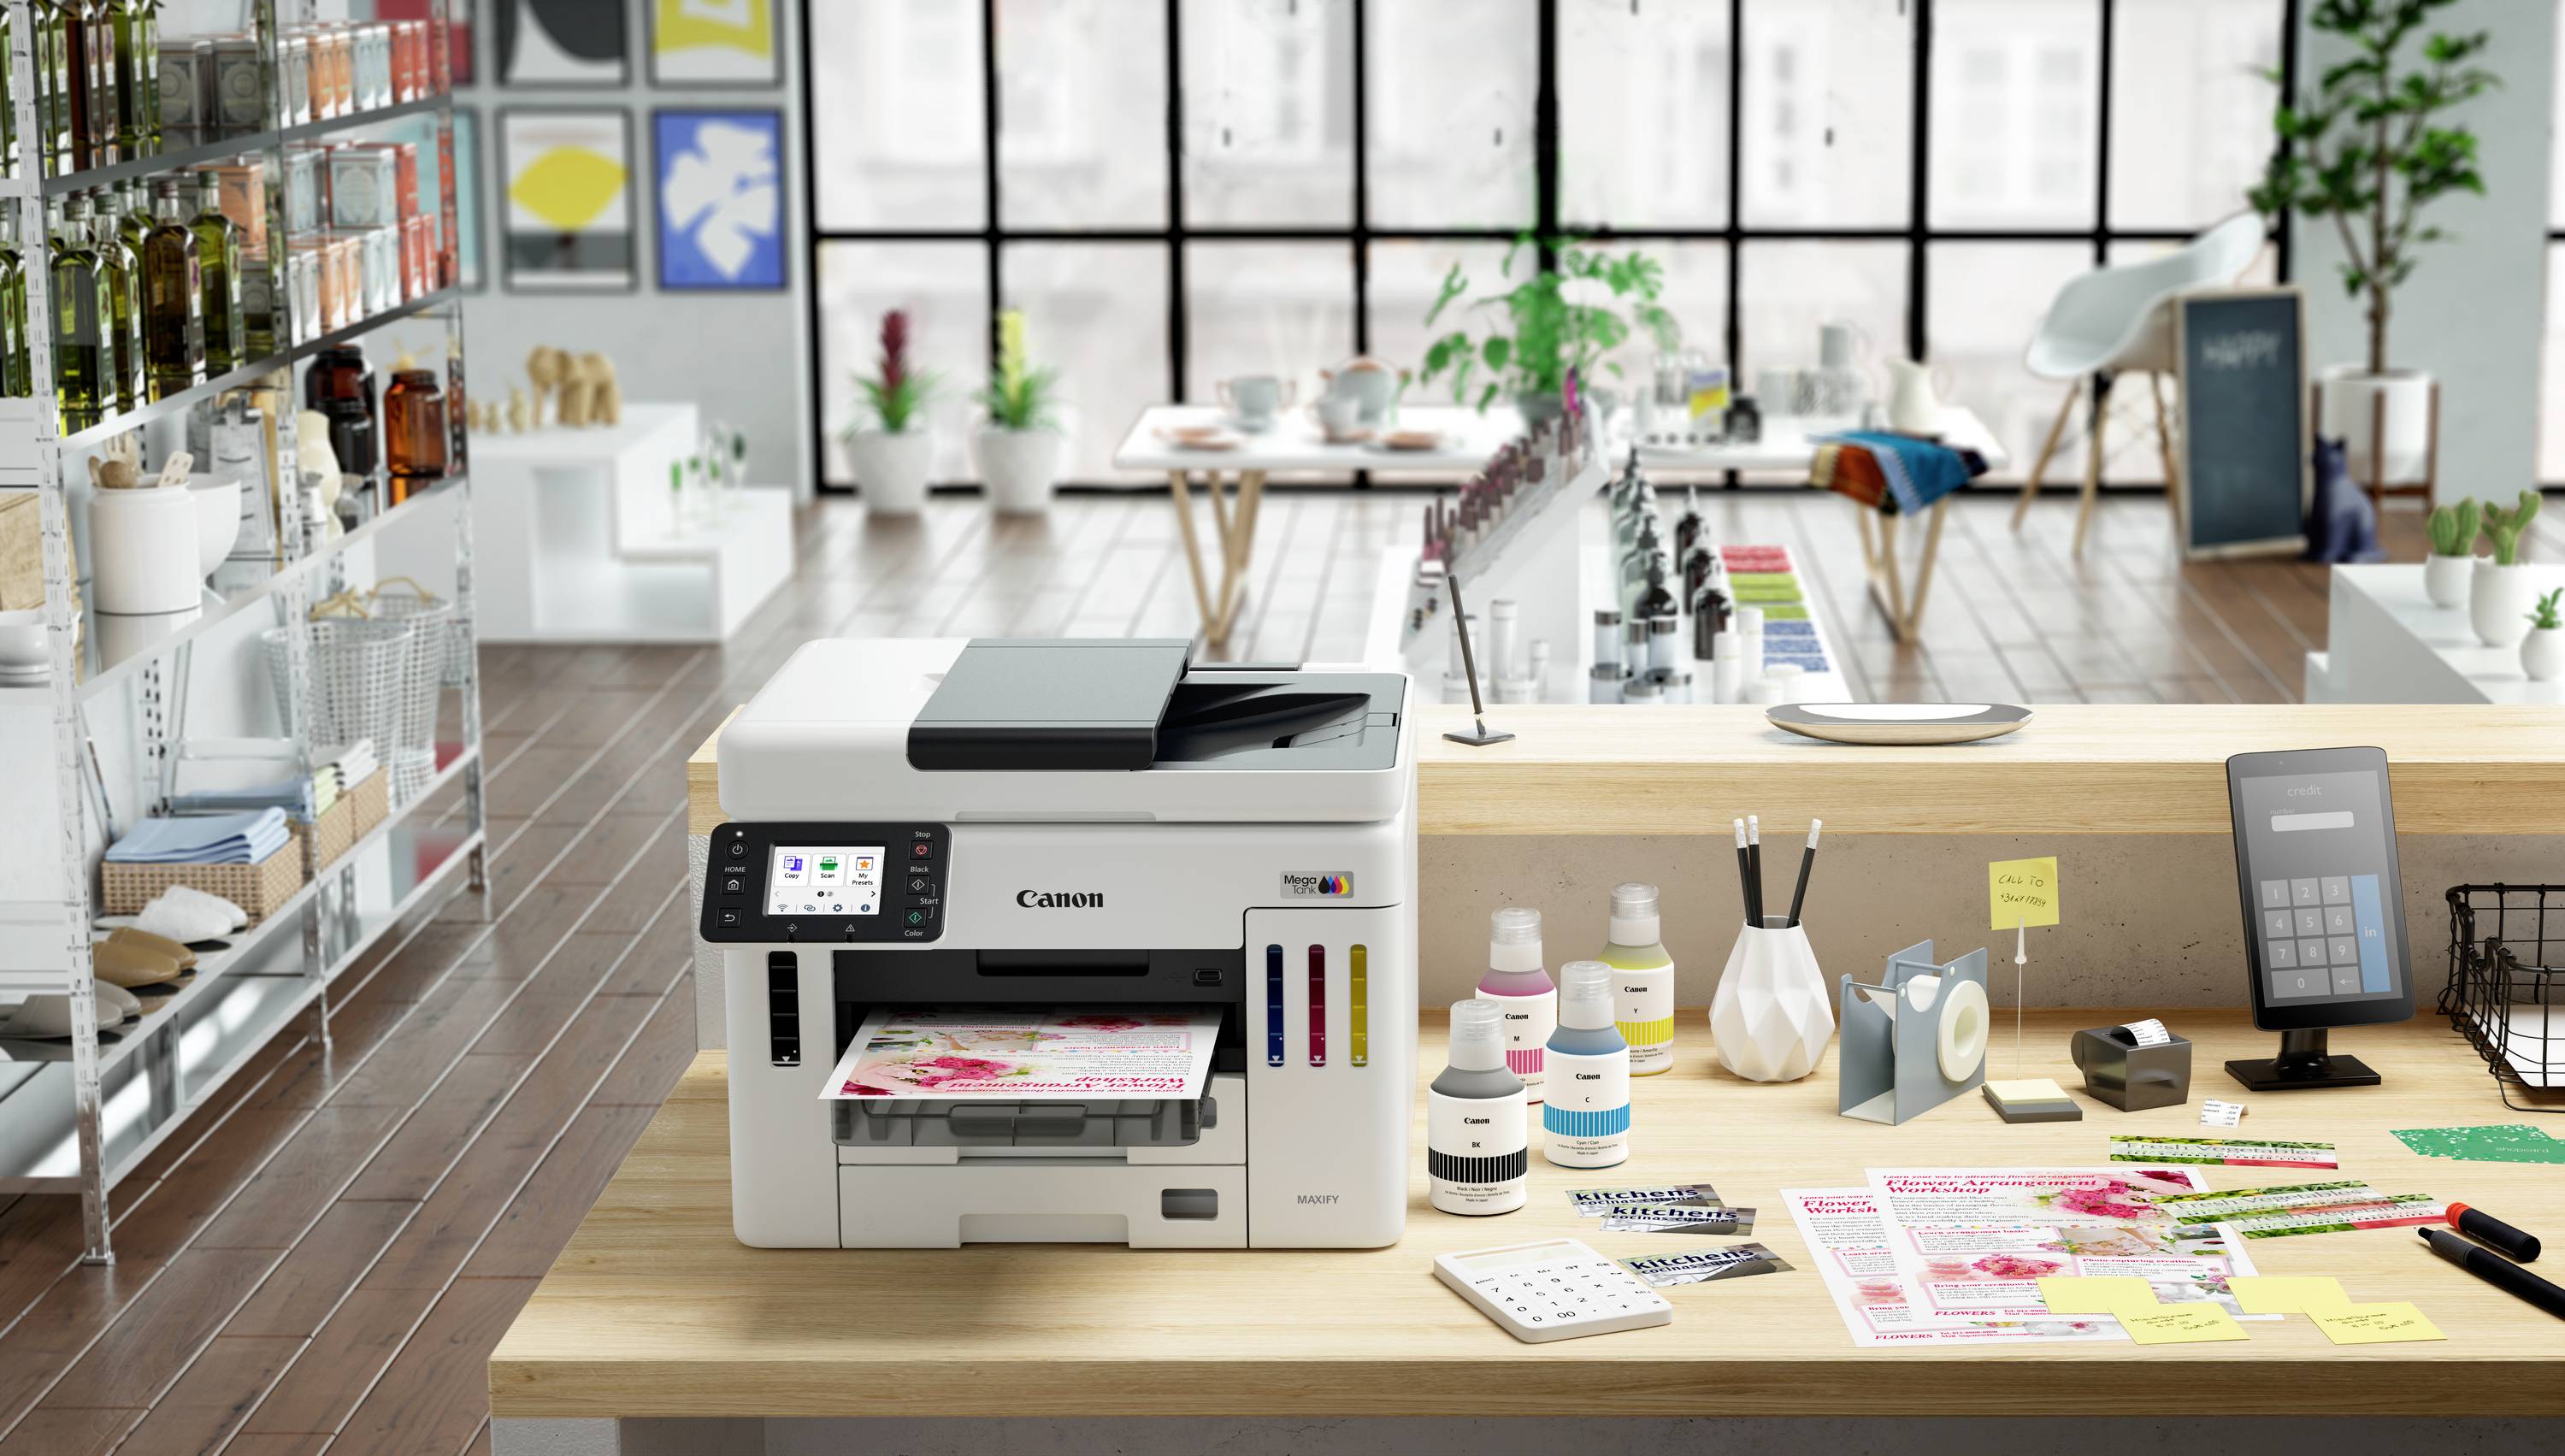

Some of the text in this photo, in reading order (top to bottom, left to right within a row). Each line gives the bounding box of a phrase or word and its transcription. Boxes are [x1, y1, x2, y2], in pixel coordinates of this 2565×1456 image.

[2287, 784, 2322, 797] credit
[1283, 875, 1317, 887] Mega
[1998, 874, 2044, 887] CALL TO
[1292, 884, 1317, 894] Tank
[2302, 887, 2309, 898] 2
[2332, 885, 2338, 896] 3
[1016, 889, 1104, 908] Canon
[2275, 917, 2284, 929] 4
[2306, 917, 2314, 928] 5
[2335, 915, 2343, 926] 6
[2364, 926, 2377, 937] in
[2279, 948, 2286, 959] 7
[2309, 946, 2316, 958] 8
[2338, 945, 2346, 956] 9
[2297, 977, 2304, 989] 0
[1464, 1117, 1490, 1125] Canon
[2195, 1145, 2320, 1155] Vegetables
[1297, 1194, 1339, 1205] MAXIFY
[1575, 1188, 1699, 1201] kitchens
[2175, 1189, 2362, 1209] Fresh Vegetables
[1613, 1206, 1738, 1218] kitchens
[2310, 1204, 2427, 1217] Vegetables
[1630, 1248, 1755, 1270] kitchens
[1642, 1264, 1698, 1274] cocinas
